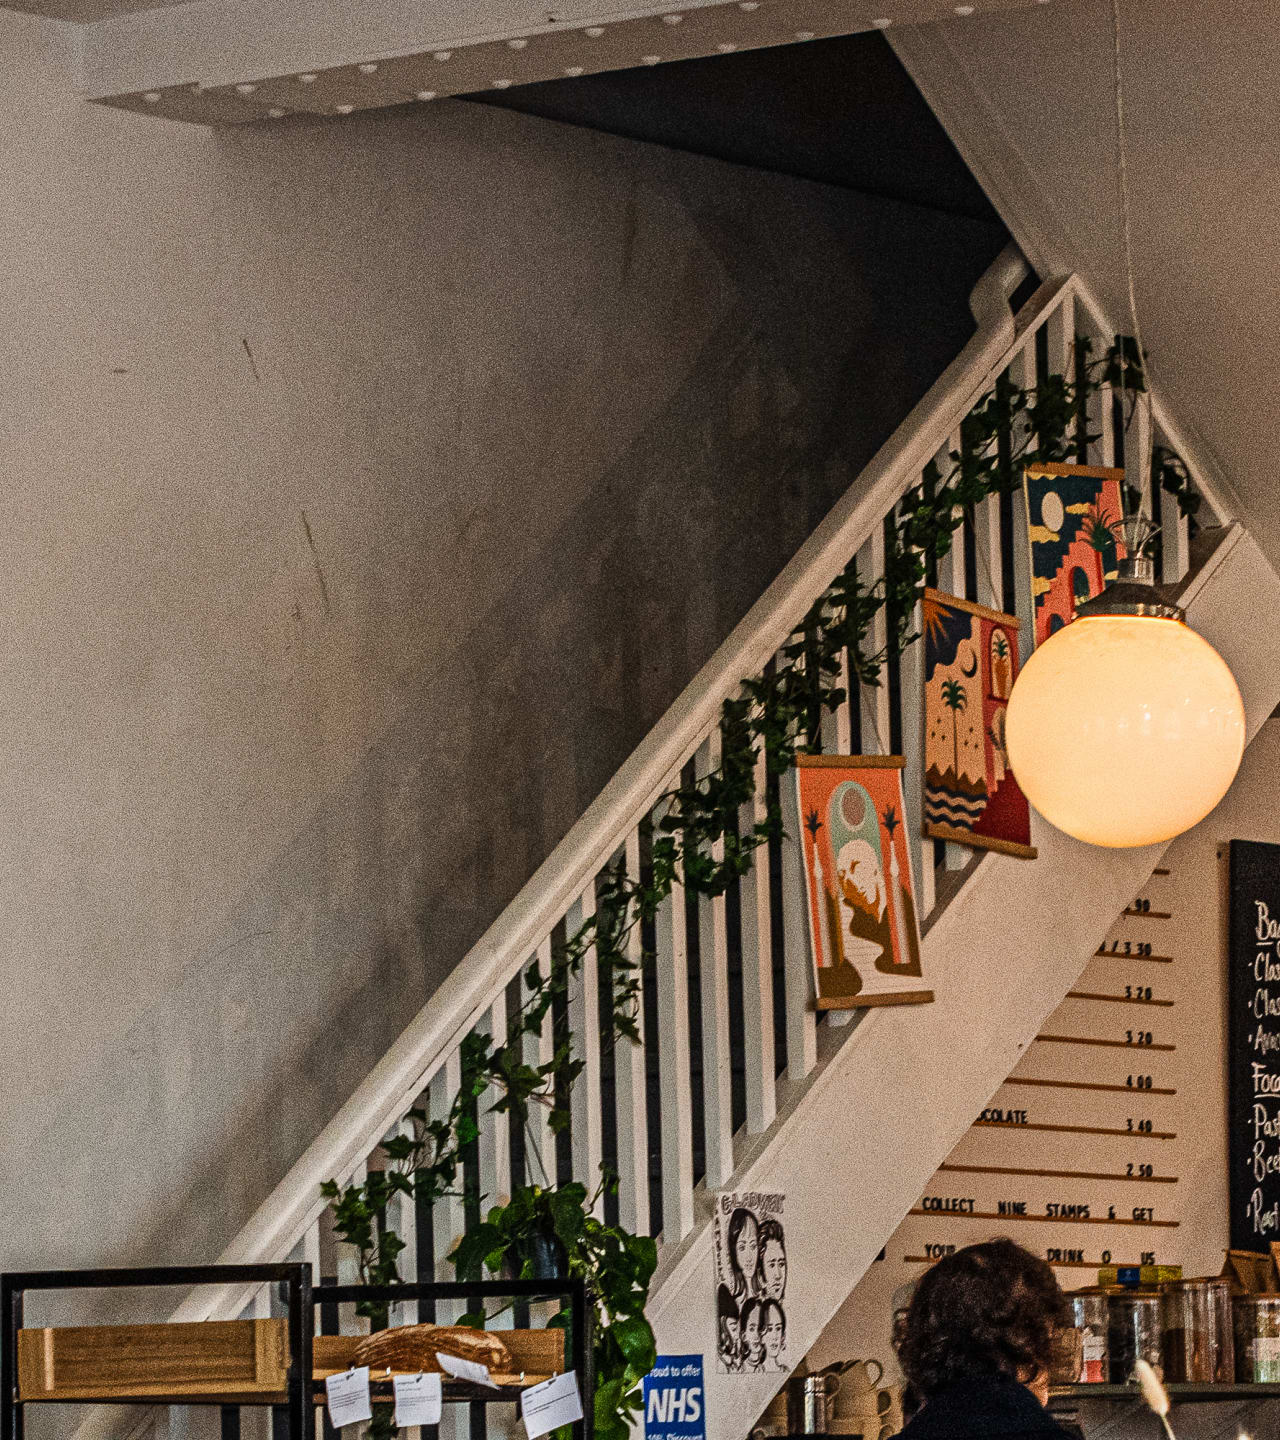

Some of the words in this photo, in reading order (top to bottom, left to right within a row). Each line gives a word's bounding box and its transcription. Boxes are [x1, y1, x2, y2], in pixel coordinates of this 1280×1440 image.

[977, 1108, 1028, 1125] COLATE
[922, 1198, 975, 1213] COLLECT
[998, 1201, 1027, 1216] NINE
[1046, 1204, 1090, 1219] STAMPS
[1109, 1206, 1116, 1220] &
[1132, 1207, 1154, 1222] GET
[1251, 1187, 1278, 1235] Roast
[1047, 1249, 1084, 1262] DRINK
[1141, 1251, 1155, 1265] US
[646, 1365, 669, 1378] roud
[671, 1366, 680, 1378] to
[681, 1364, 701, 1378] offer
[647, 1387, 701, 1423] NHS
